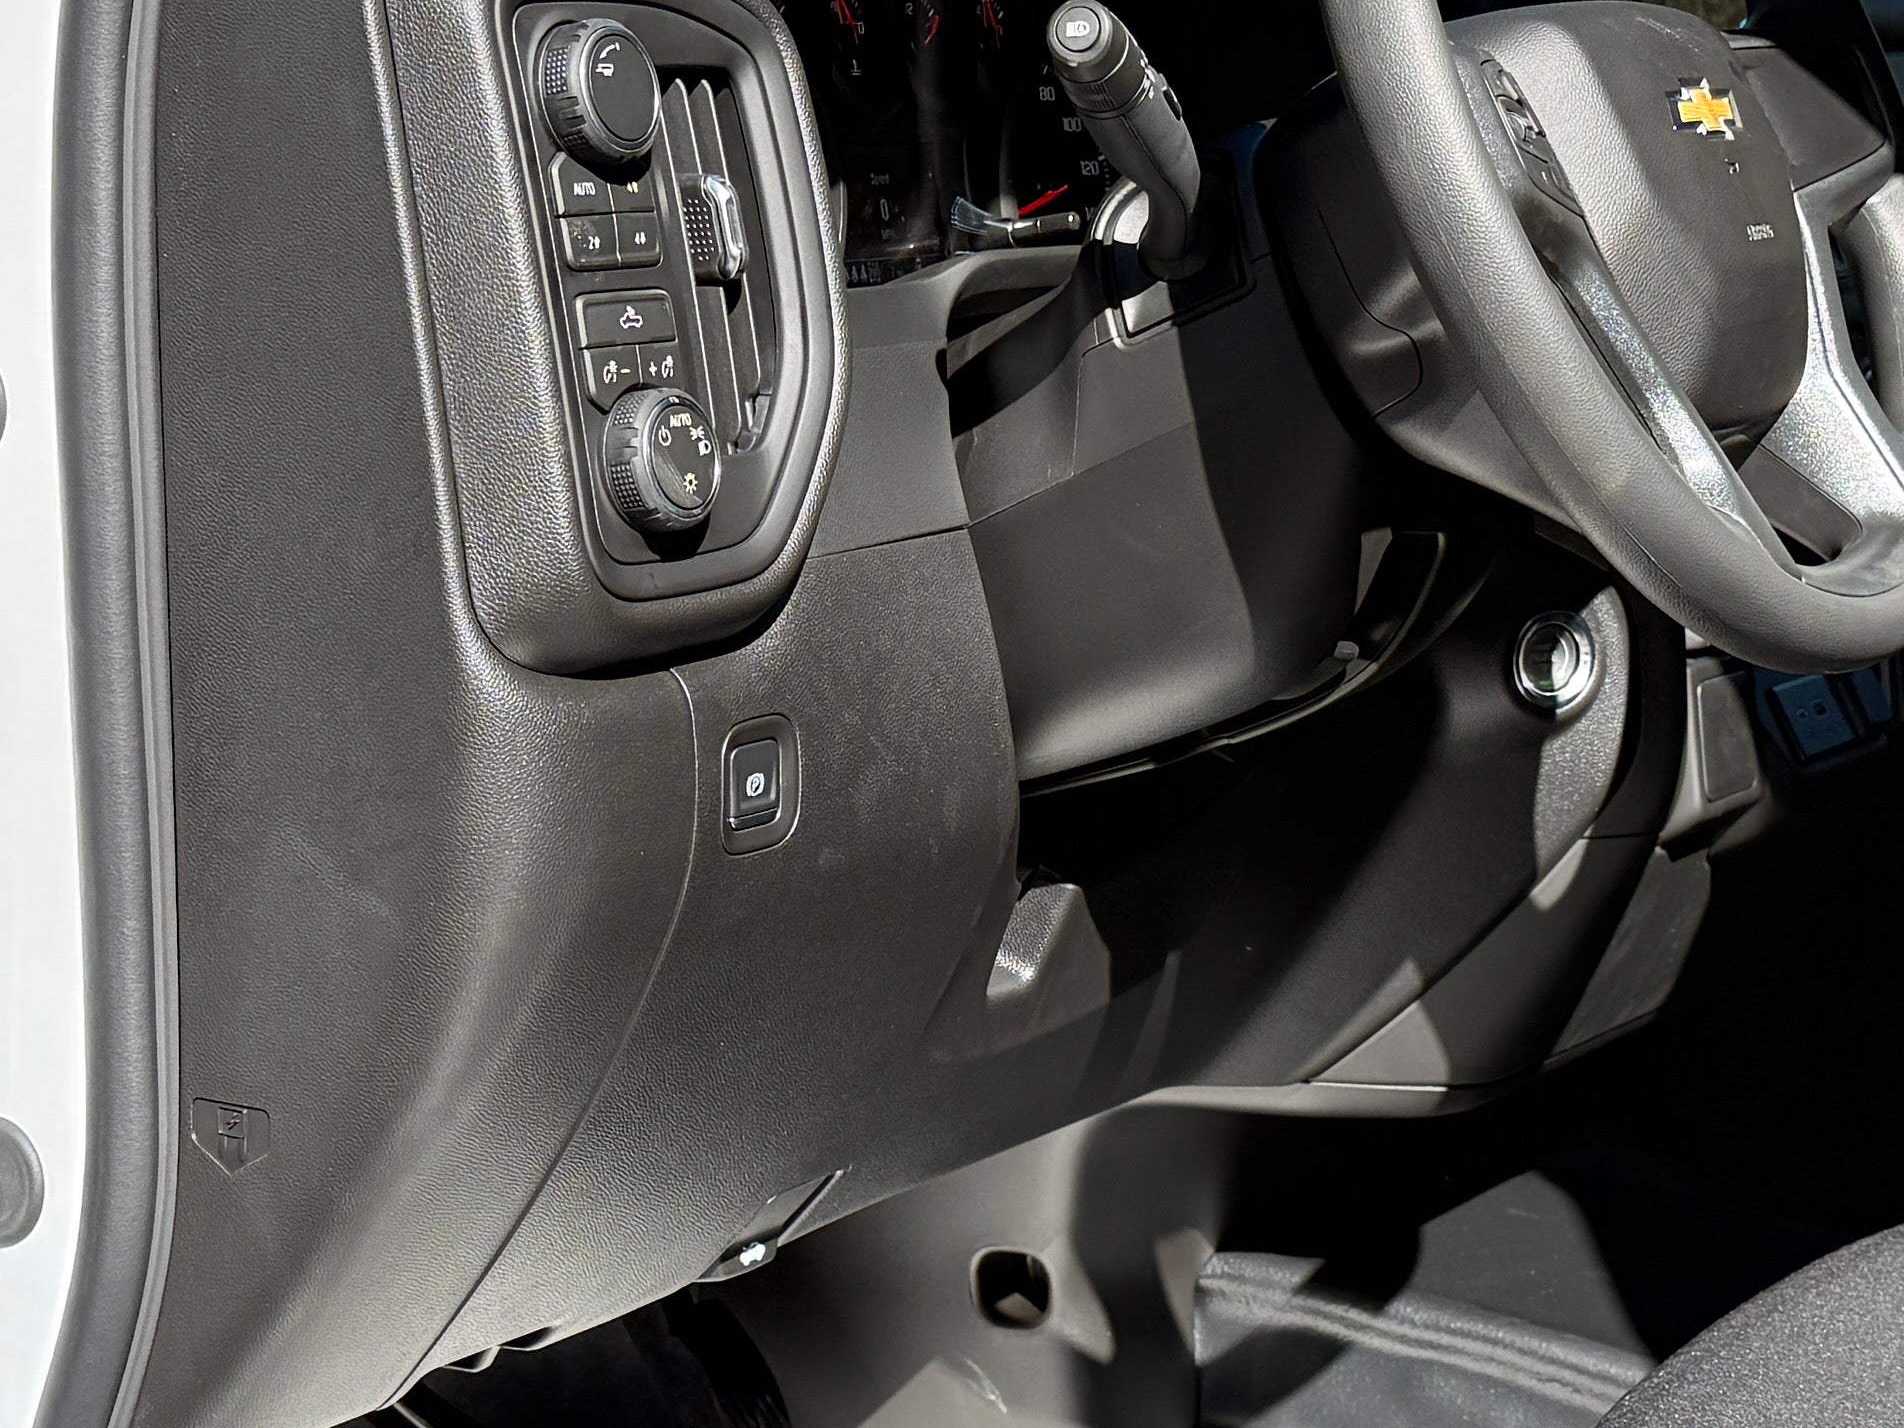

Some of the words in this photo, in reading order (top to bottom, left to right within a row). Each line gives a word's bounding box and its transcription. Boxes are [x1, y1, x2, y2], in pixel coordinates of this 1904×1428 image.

[1039, 86, 1055, 101] 80
[573, 181, 596, 196] AUTO
[669, 412, 693, 428] AUTO
